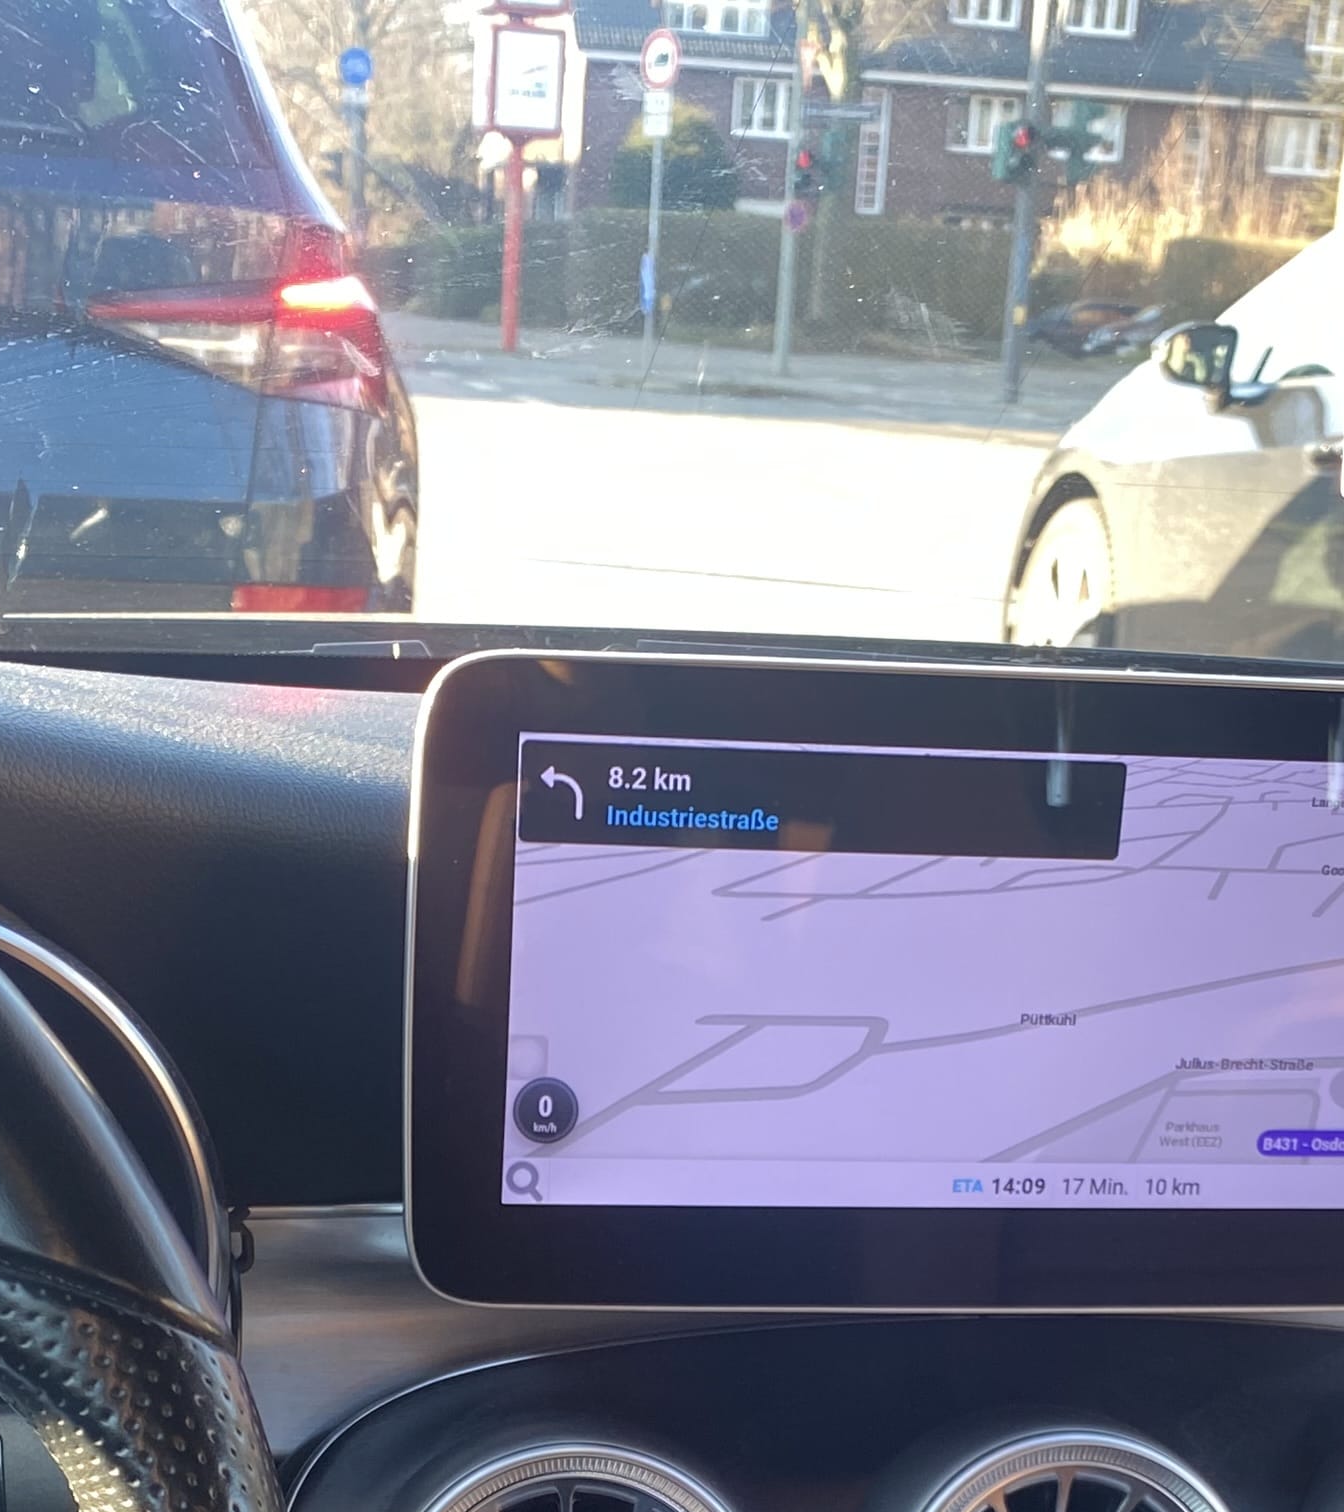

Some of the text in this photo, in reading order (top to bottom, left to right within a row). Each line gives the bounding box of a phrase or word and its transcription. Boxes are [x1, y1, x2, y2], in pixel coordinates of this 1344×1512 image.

[608, 766, 691, 793] 8.2 km
[607, 806, 779, 832] Industriestraße
[1175, 1057, 1314, 1071] Julius-Brecht-Straße
[538, 1095, 552, 1118] 0
[533, 1122, 557, 1133] km/h
[1165, 1121, 1220, 1133] Parkhaus
[1159, 1136, 1189, 1147] West
[1263, 1137, 1299, 1151] B431
[952, 1179, 1200, 1195] ETA 14:09 17 Min. 10 km
